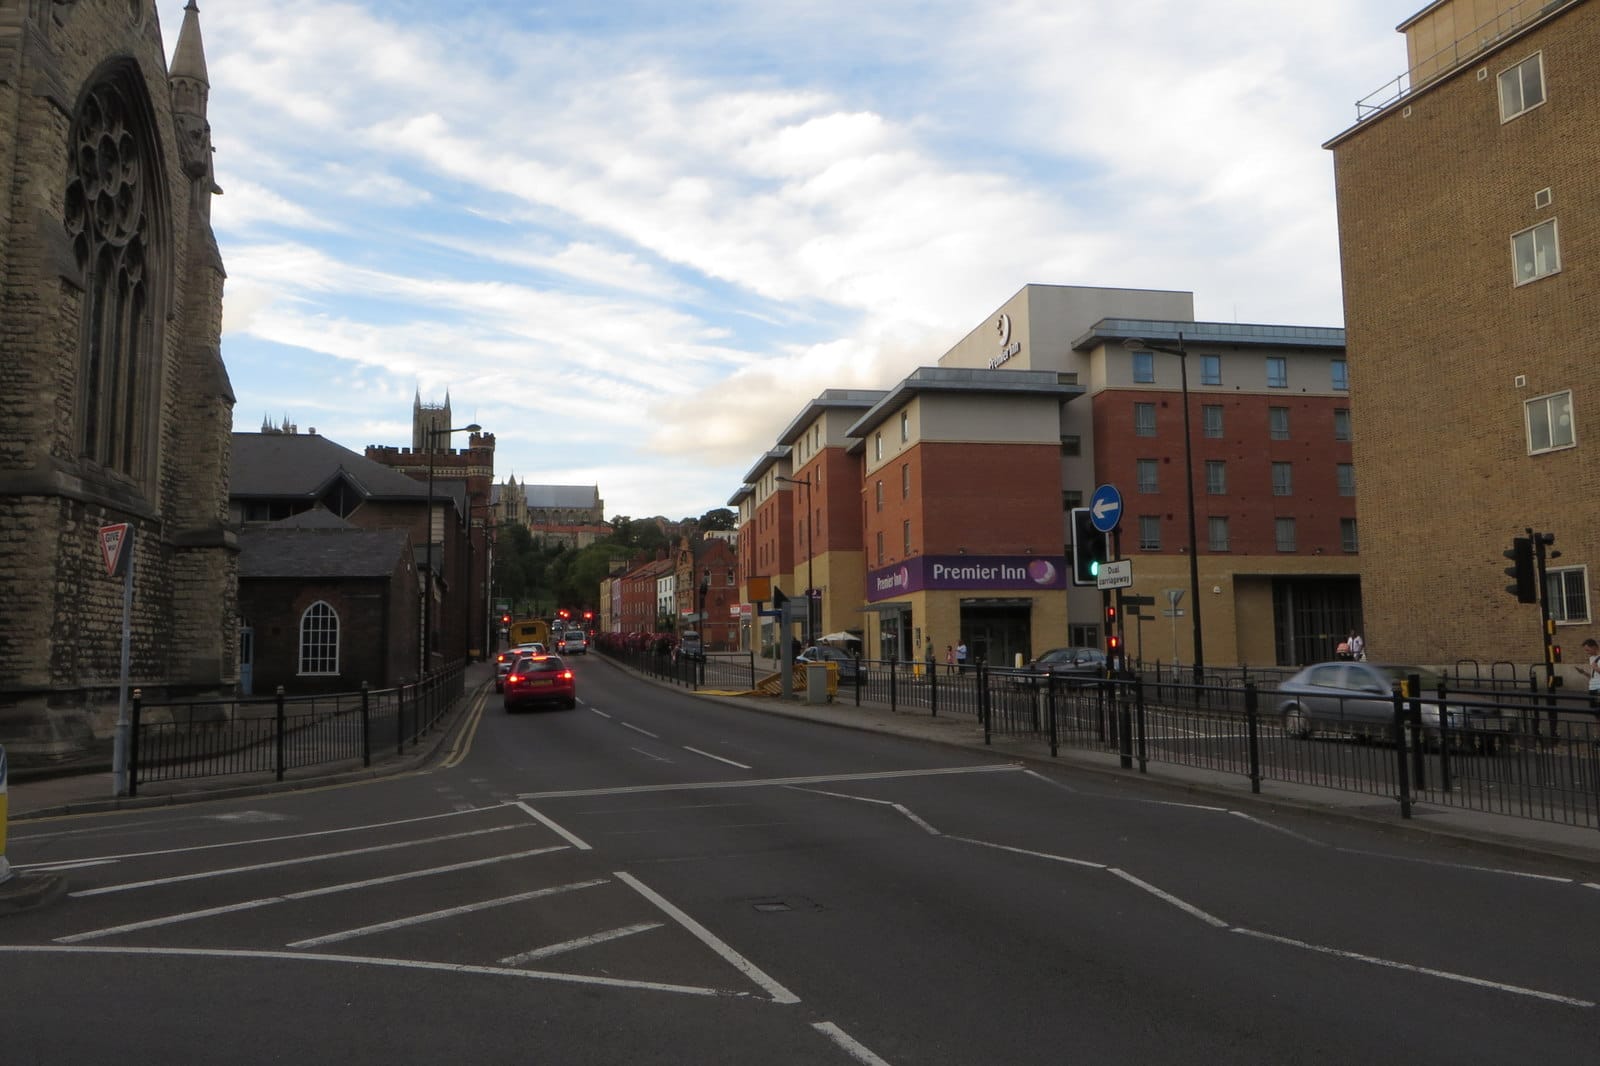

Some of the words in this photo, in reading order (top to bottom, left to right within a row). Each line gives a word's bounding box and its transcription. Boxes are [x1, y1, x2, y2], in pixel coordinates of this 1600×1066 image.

[105, 531, 120, 542] GIVE
[933, 564, 998, 580] Premier
[1001, 564, 1026, 580] Inn
[1107, 566, 1120, 574] Dual
